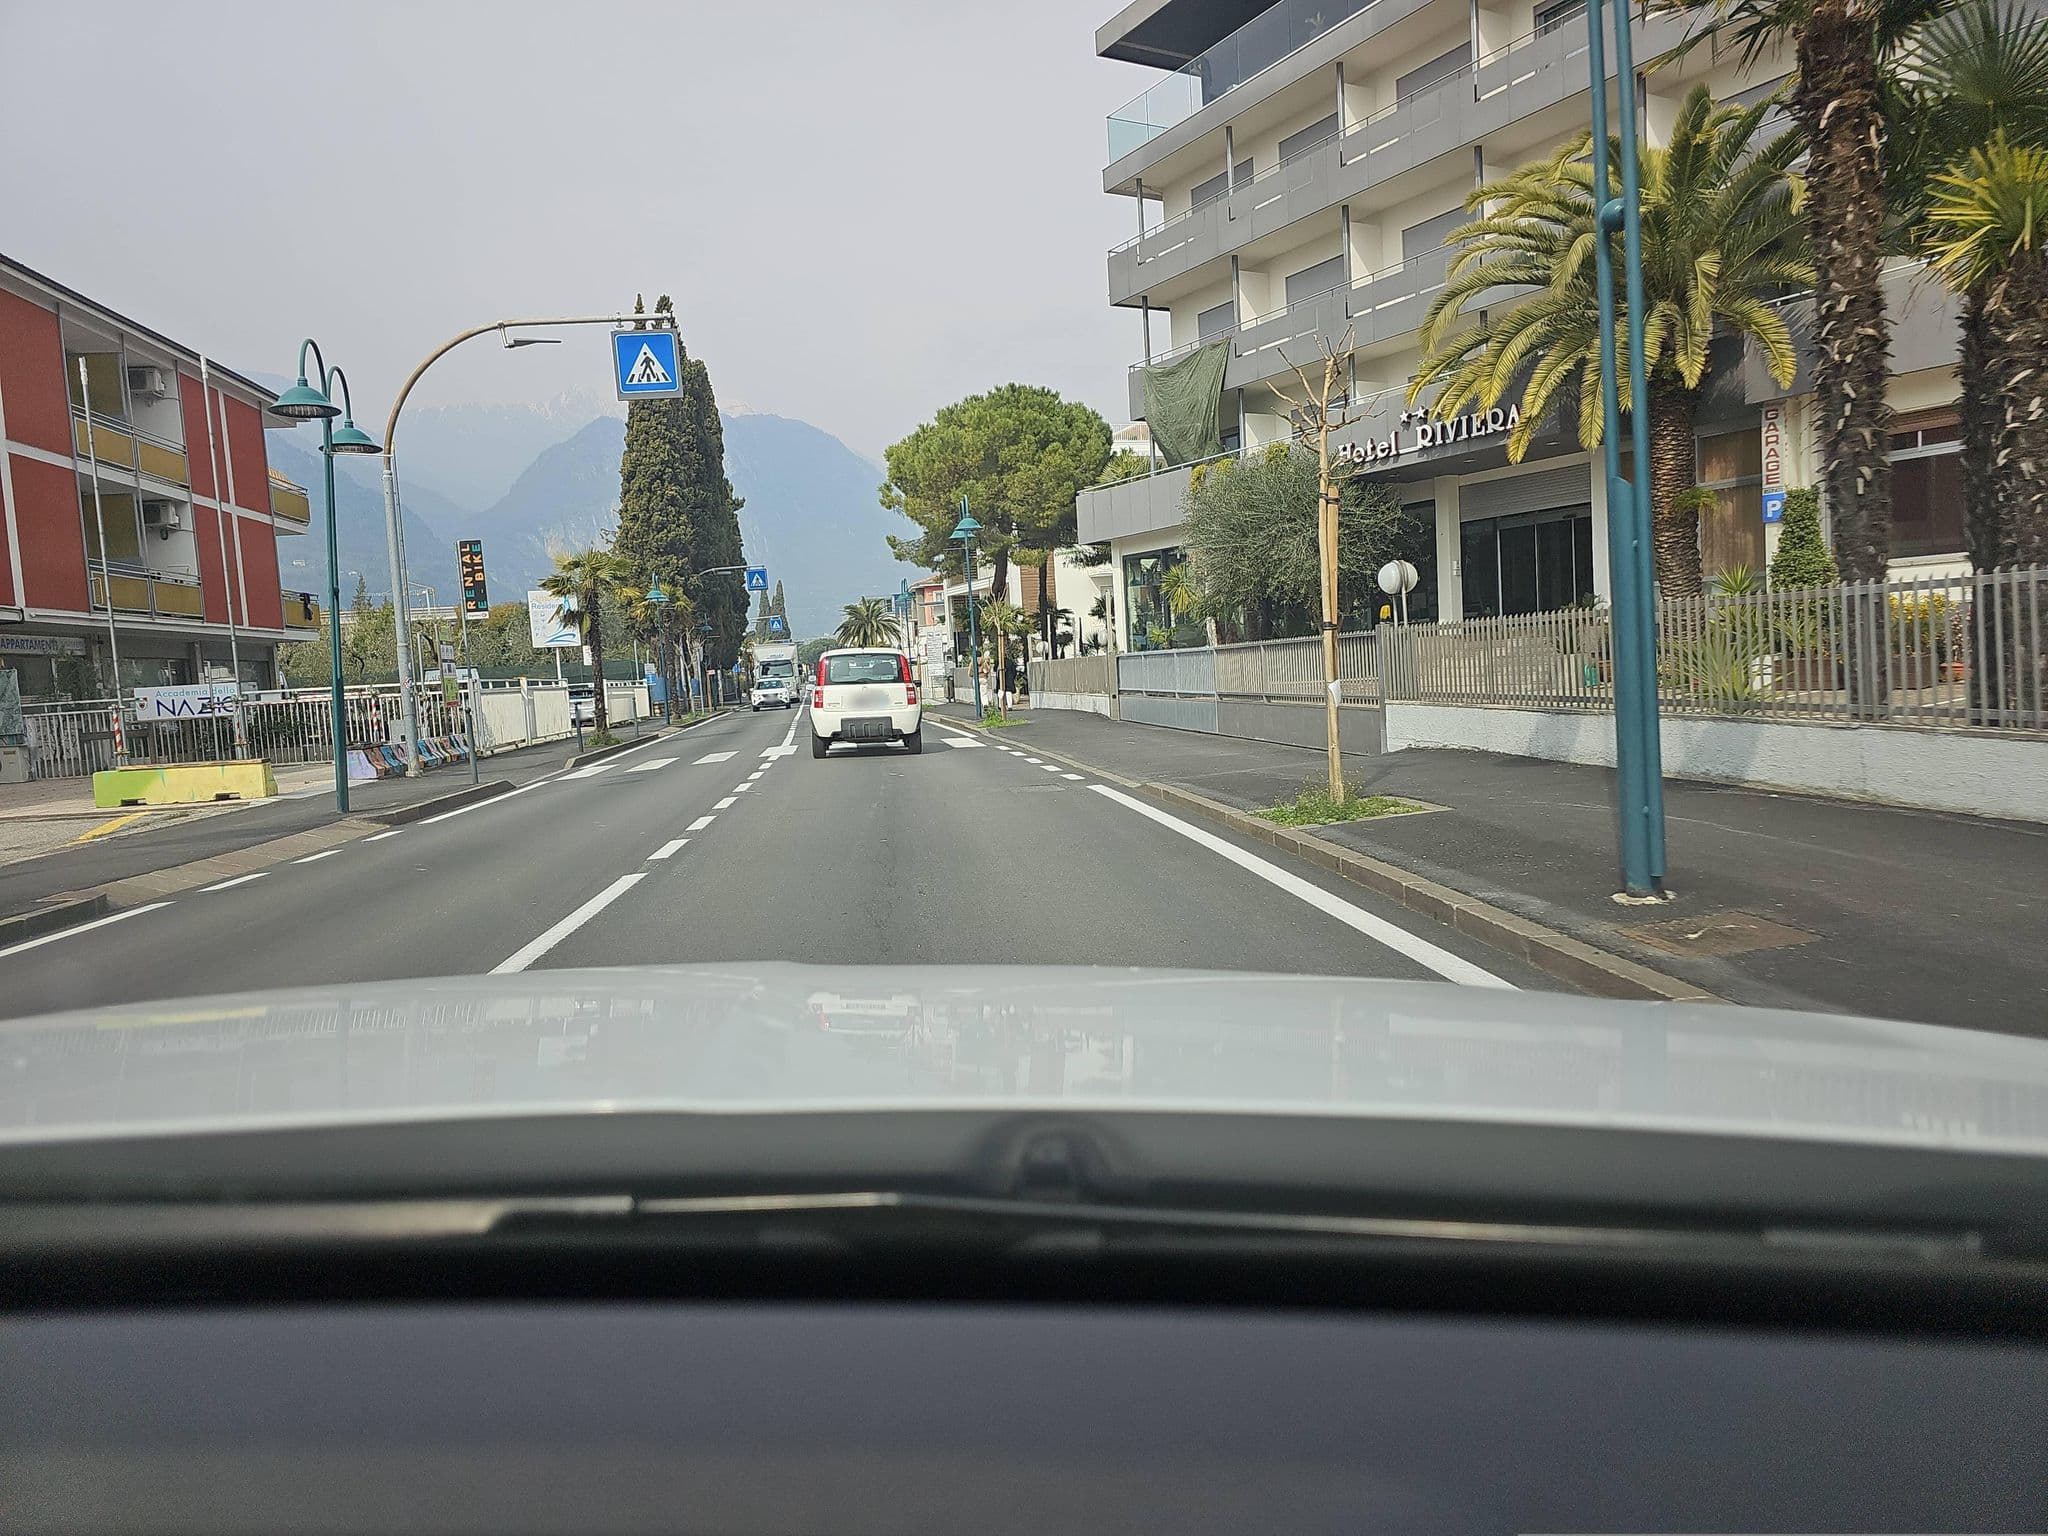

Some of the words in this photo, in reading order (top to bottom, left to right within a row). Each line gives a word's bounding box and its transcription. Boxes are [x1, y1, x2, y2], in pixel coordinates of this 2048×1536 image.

[1338, 431, 1400, 463] Hotel
[1416, 403, 1523, 449] RIVIERA
[1765, 408, 1780, 486] GARAGE
[1766, 500, 1782, 518] P
[461, 543, 477, 610] RENTAL
[155, 686, 208, 698] Accademia
